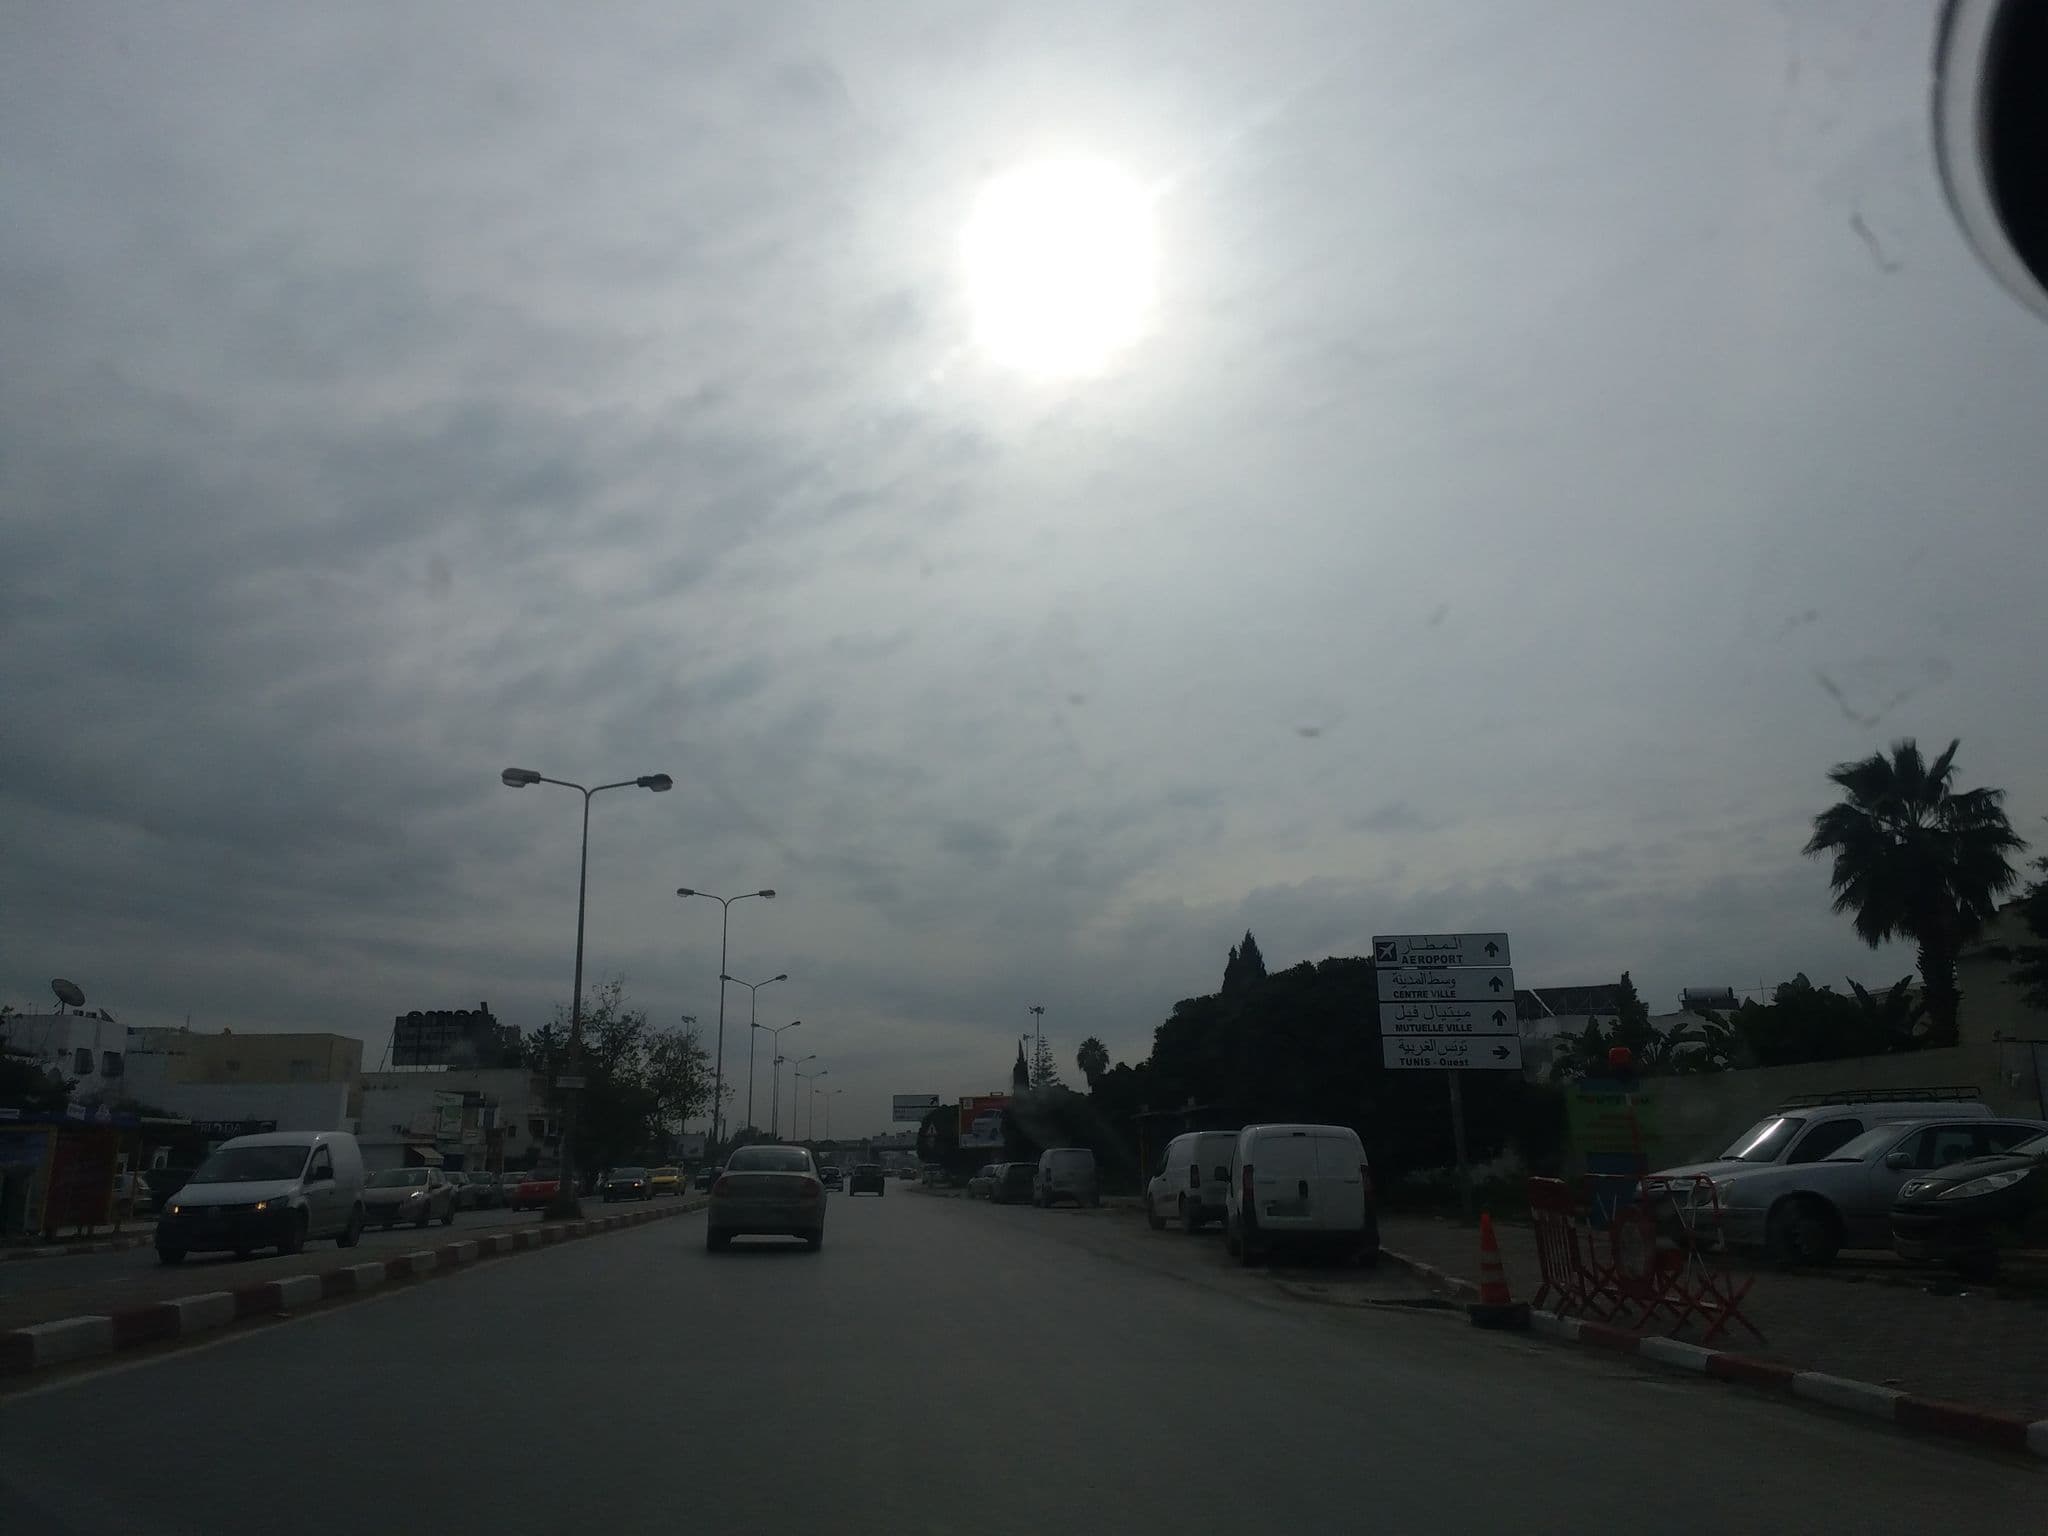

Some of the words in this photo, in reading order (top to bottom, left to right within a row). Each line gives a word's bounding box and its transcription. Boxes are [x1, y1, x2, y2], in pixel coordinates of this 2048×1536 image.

[1402, 955, 1463, 964] AEROPORT
[1394, 991, 1428, 999] CENTRE
[1432, 990, 1456, 998] VILLE
[1395, 1024, 1443, 1032] MUTUELLE
[1447, 1024, 1472, 1032] VILLE
[1400, 1058, 1430, 1066] TUNIS
[1439, 1057, 1469, 1066] Ouest
